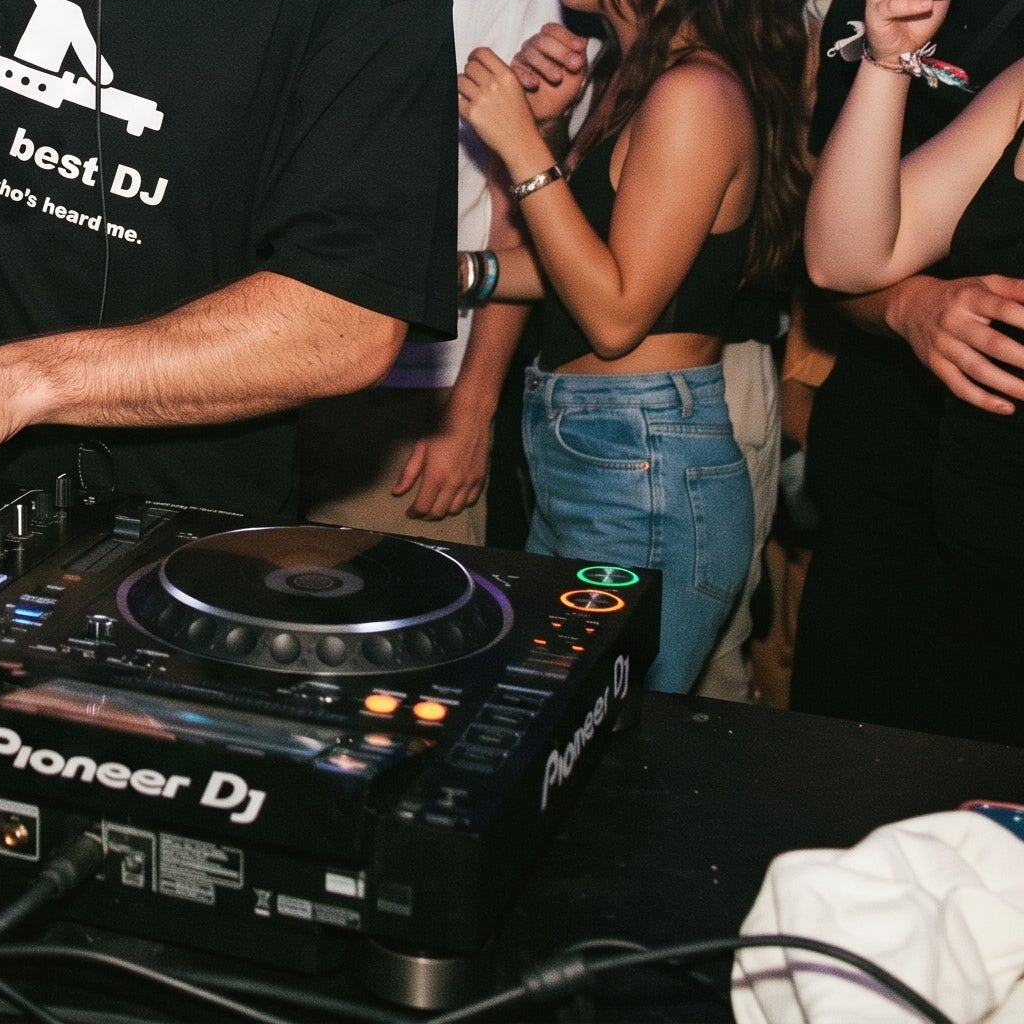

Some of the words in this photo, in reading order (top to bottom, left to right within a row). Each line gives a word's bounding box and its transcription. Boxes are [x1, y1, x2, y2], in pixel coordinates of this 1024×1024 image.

[9, 127, 99, 187] best
[109, 163, 169, 206] DJ
[42, 196, 103, 232] heard
[106, 222, 143, 245] me.
[541, 686, 610, 810] Pioneer
